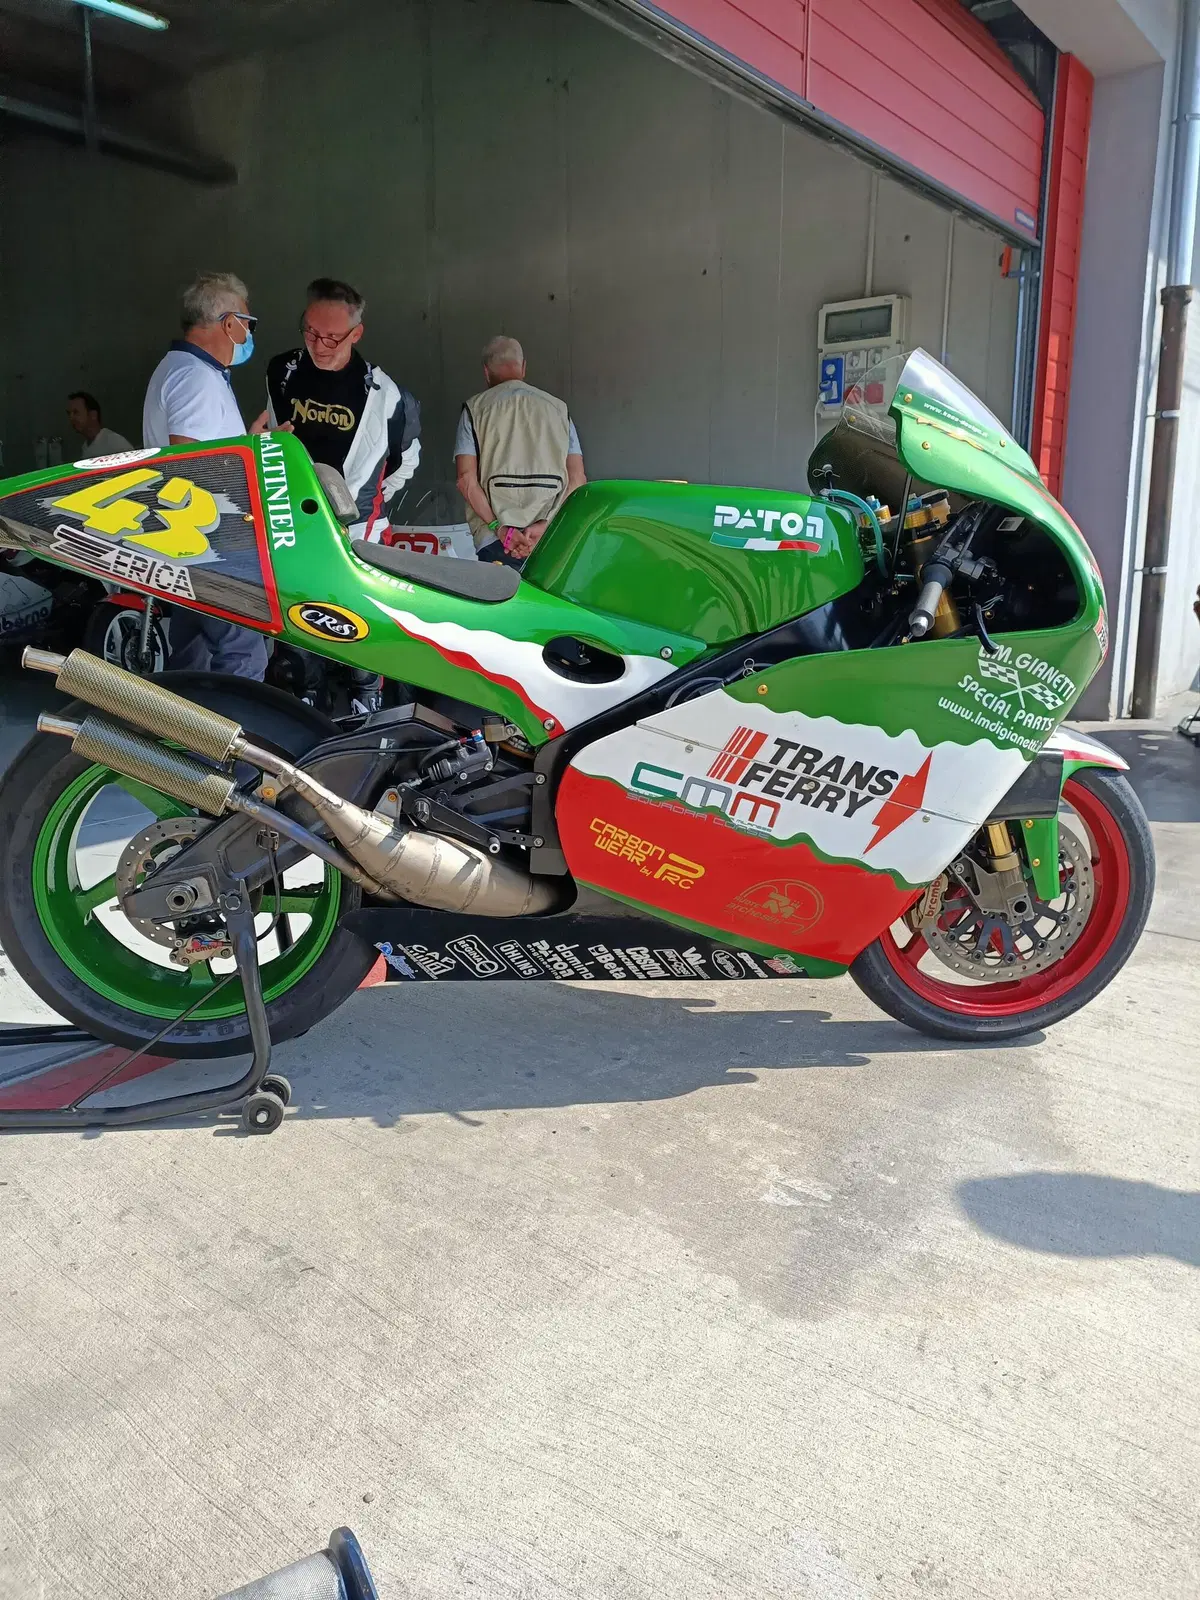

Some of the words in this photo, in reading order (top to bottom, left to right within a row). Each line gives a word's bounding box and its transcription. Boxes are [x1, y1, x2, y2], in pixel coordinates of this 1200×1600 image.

[291, 398, 356, 431] Norton
[52, 468, 219, 559] 43
[1015, 653, 1077, 701] GIANETTI
[957, 674, 1012, 719] SPECIAL
[1013, 709, 1055, 731] PARTS
[767, 737, 899, 796] TRANS
[626, 792, 708, 821] SQUADRA
[739, 762, 877, 818] FERRY
[594, 834, 646, 866] WEAR
[639, 865, 652, 877] by
[457, 940, 483, 962] REGINA
[554, 943, 595, 980] domino
[595, 953, 626, 979] Beta
